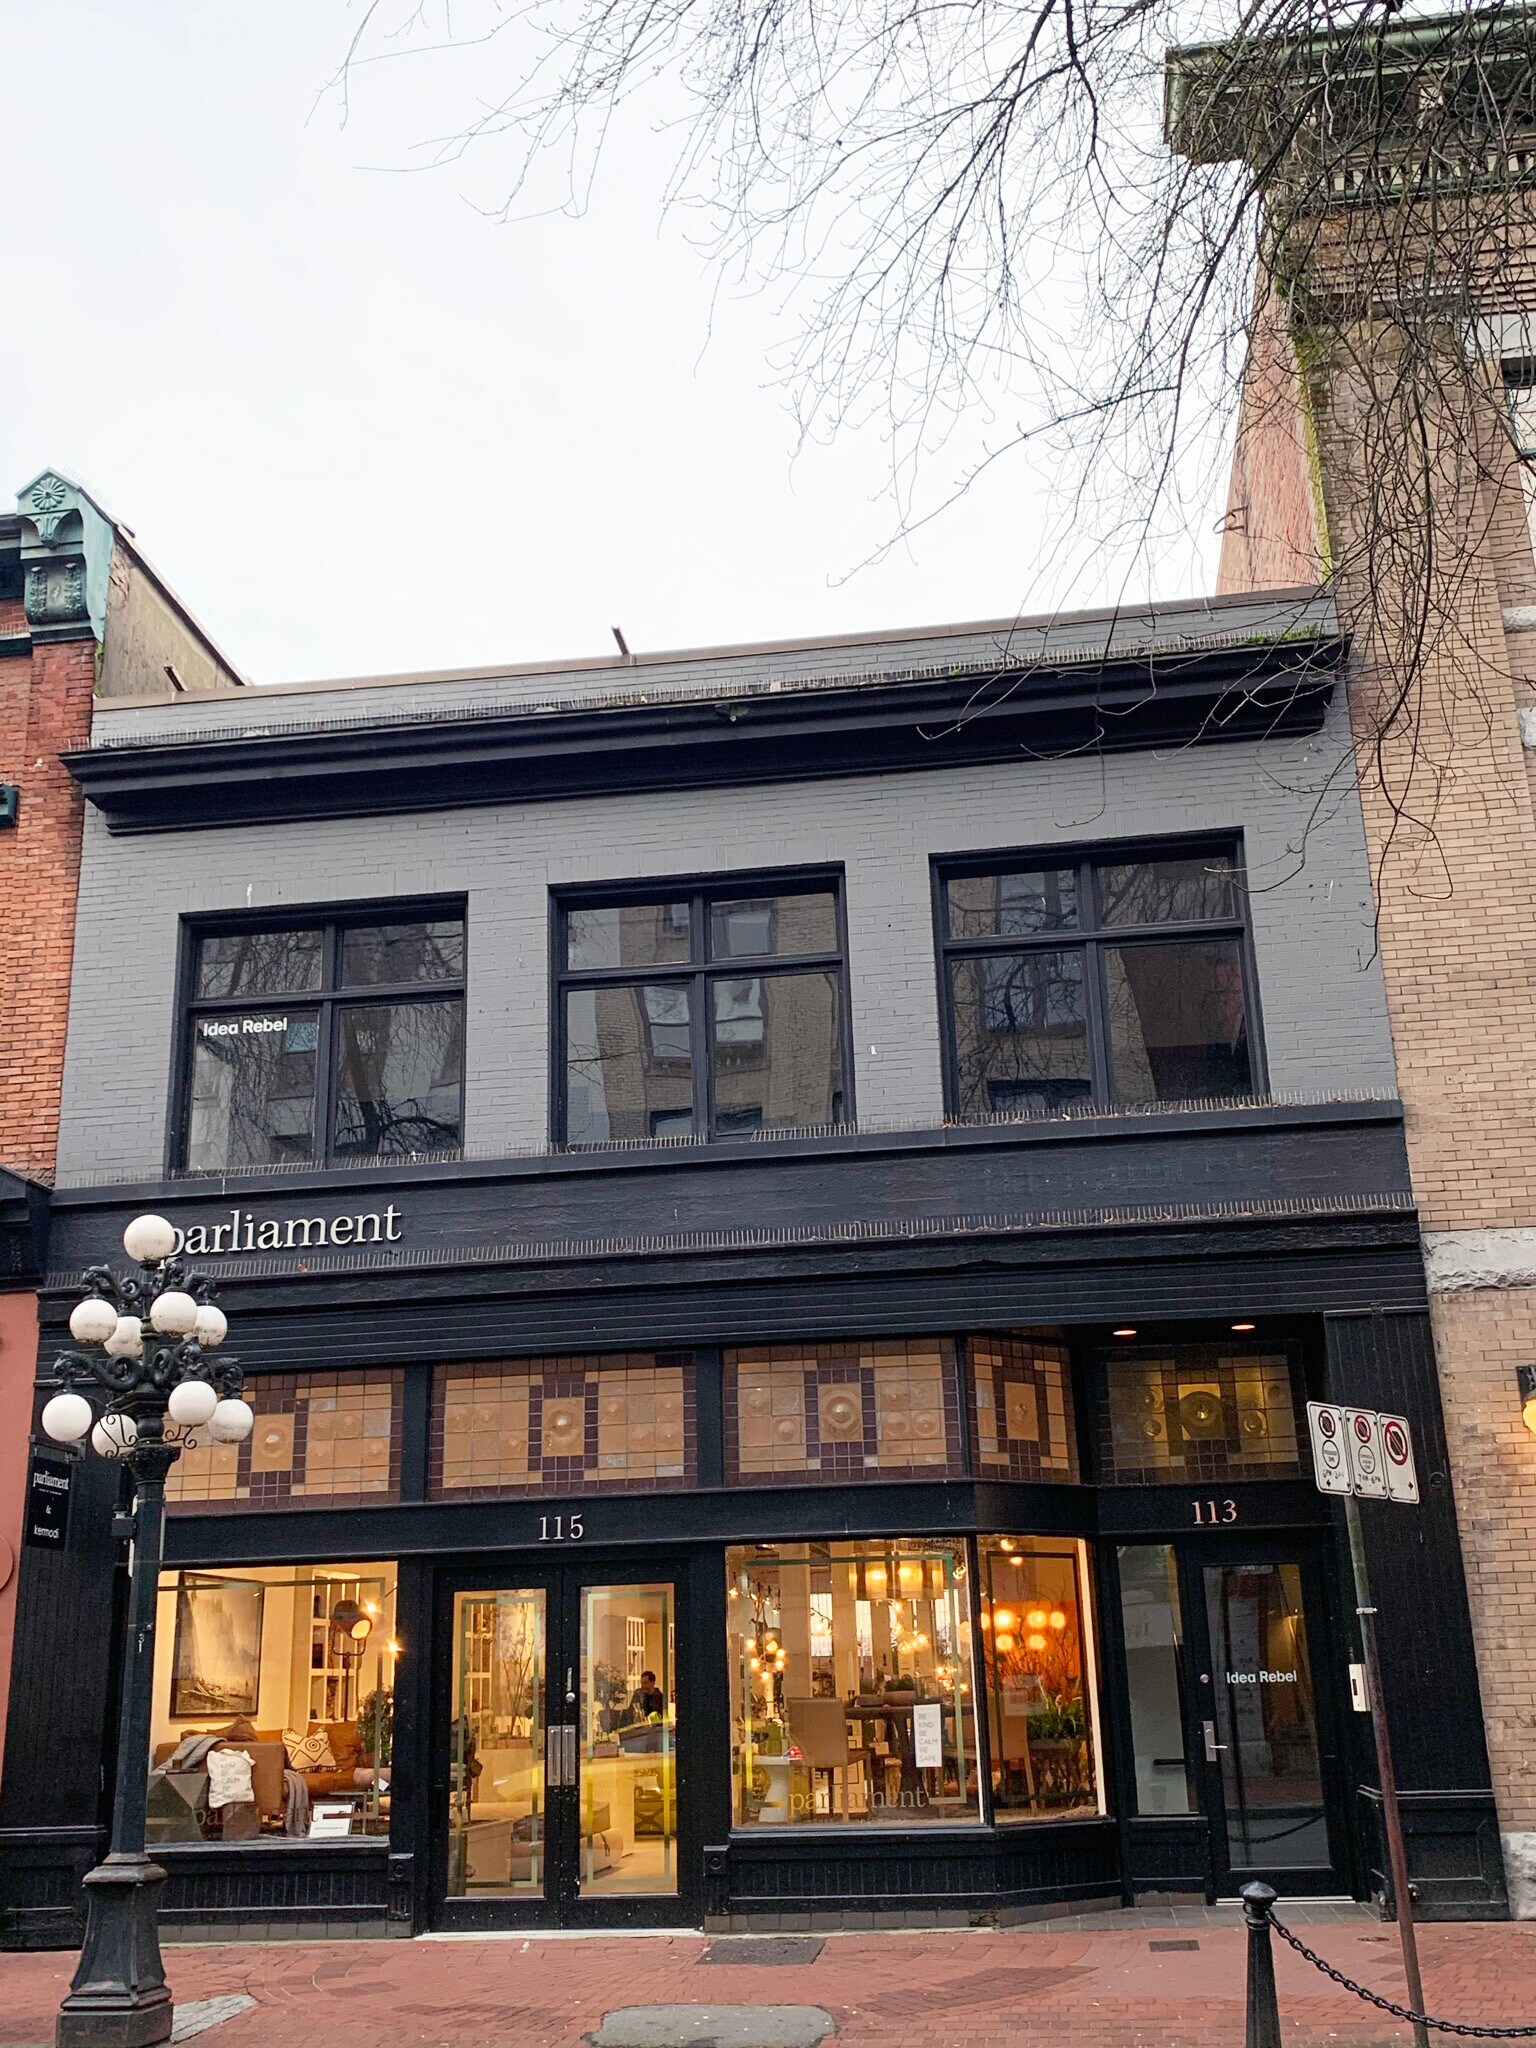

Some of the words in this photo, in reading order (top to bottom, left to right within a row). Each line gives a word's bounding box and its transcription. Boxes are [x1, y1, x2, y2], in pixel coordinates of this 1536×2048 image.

[203, 1019, 239, 1036] Idea
[242, 1017, 288, 1033] Rebel
[32, 1470, 69, 1490] parliament
[45, 1504, 52, 1515] &
[1191, 1499, 1238, 1524] 113
[538, 1513, 585, 1541] 115
[1226, 1671, 1257, 1683] Idea
[1259, 1670, 1298, 1683] Rebel
